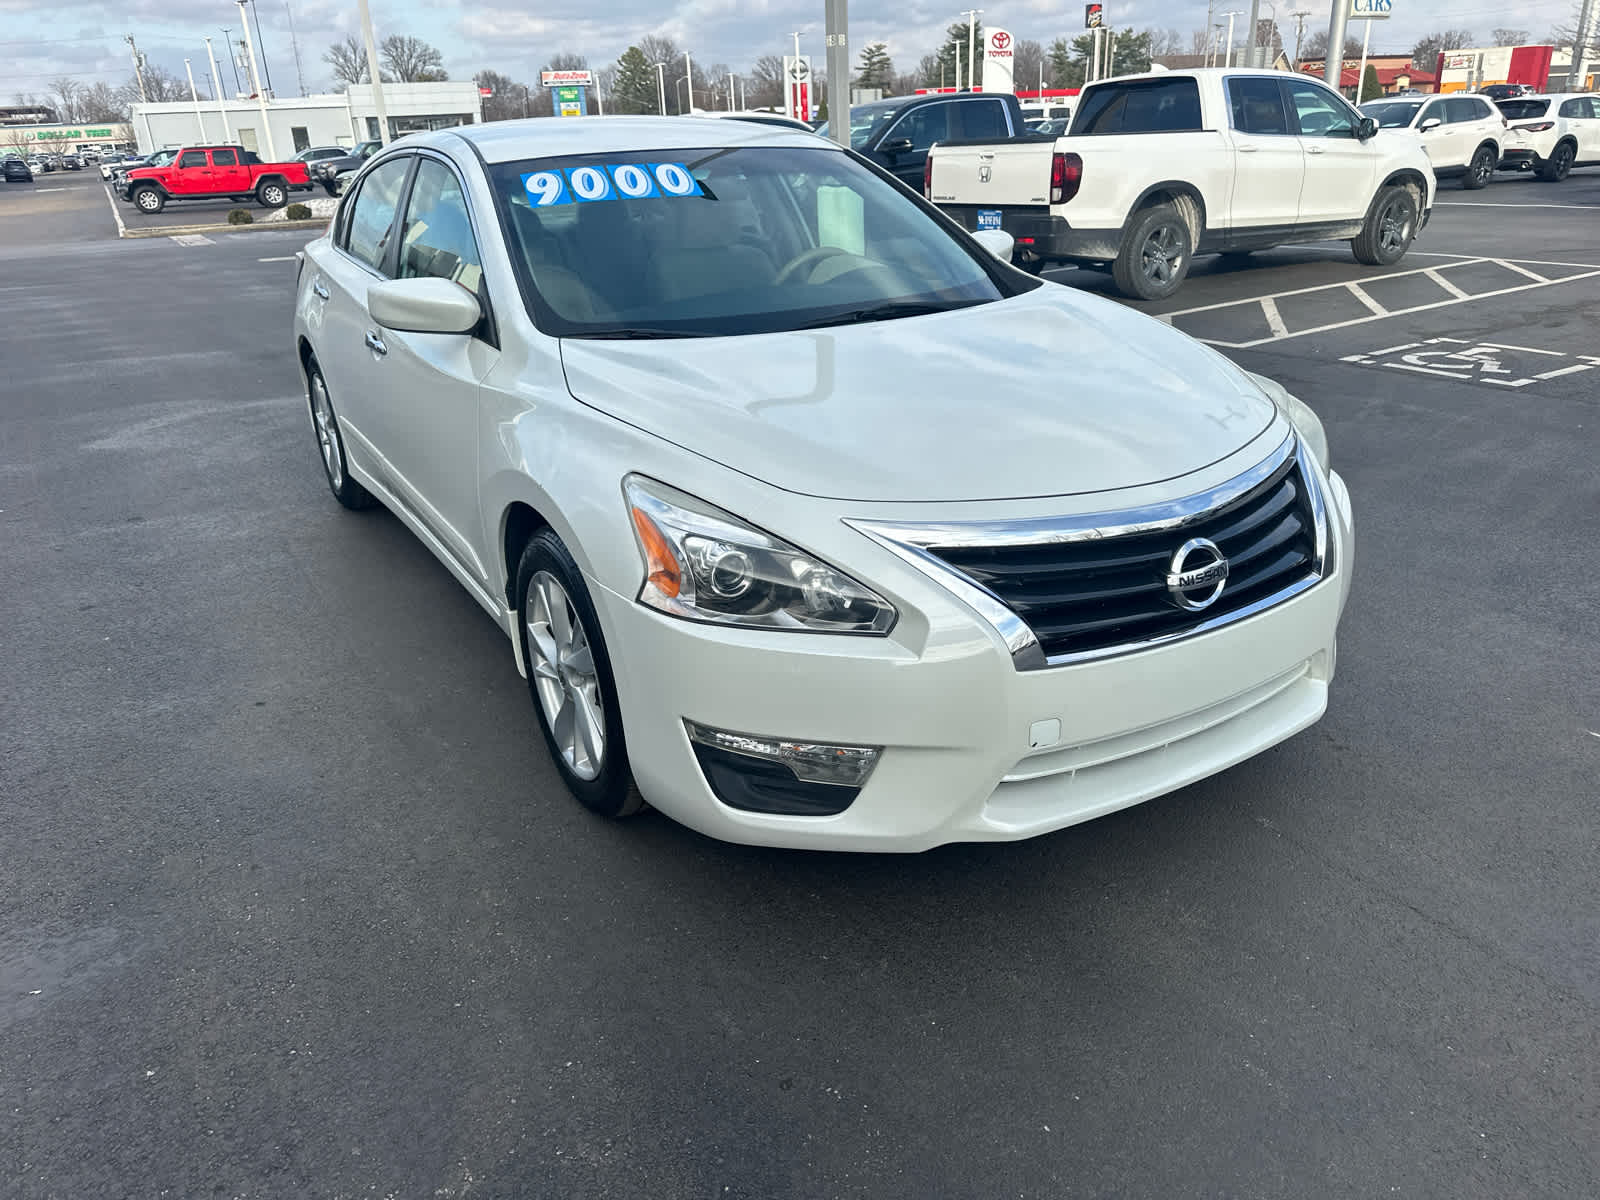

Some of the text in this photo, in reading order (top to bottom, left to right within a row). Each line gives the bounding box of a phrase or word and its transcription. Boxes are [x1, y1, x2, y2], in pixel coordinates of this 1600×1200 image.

[1354, 0, 1392, 12] CARS
[37, 129, 112, 140] DOLLAR TREE
[526, 163, 694, 205] 9000
[1179, 565, 1227, 587] NISSAN
